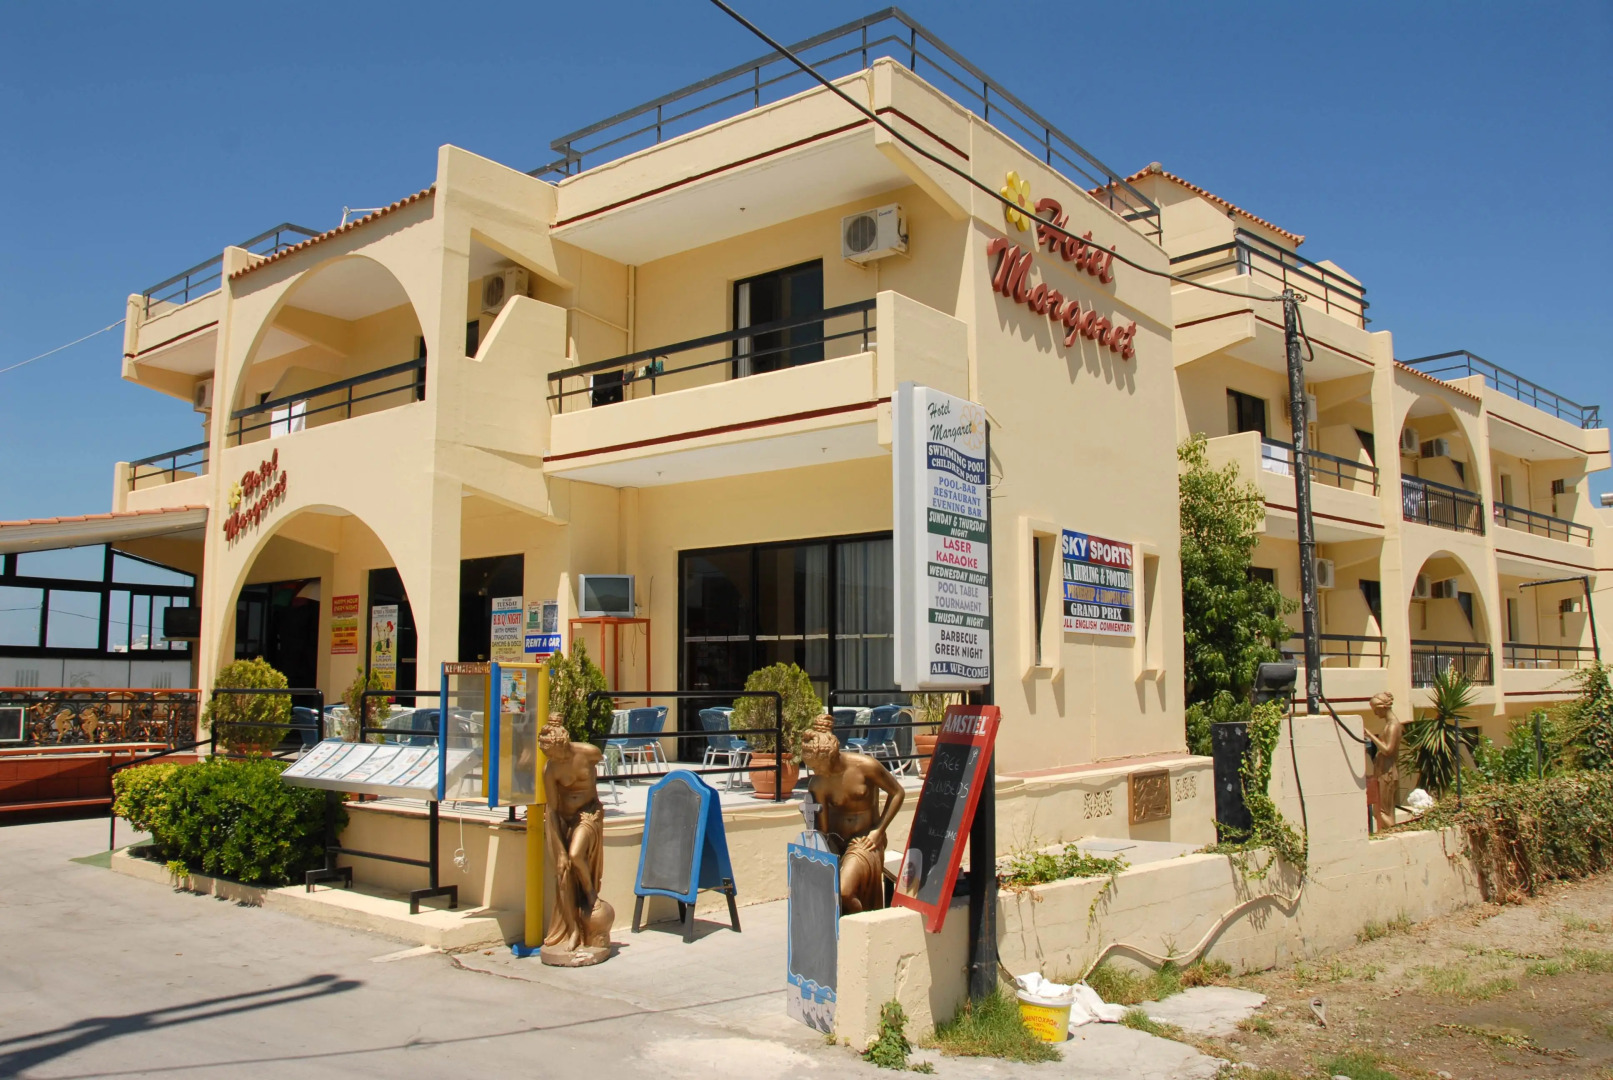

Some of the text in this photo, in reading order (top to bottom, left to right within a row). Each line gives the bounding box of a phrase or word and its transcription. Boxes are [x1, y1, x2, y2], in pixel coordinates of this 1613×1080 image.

[1034, 198, 1116, 284] Hotel
[987, 238, 1137, 360] Margaret
[928, 400, 950, 419] Hotel
[930, 421, 972, 442] Margaret
[928, 445, 985, 473] SWIMMING POOL
[241, 448, 278, 497] Hotel
[931, 458, 982, 484] CHILDREN POOL
[939, 477, 977, 495] POOL-BAR
[223, 470, 287, 541] Margaret
[933, 486, 981, 506] RESTAURANT
[932, 498, 982, 518] EVENING BAR
[929, 511, 986, 533] SUNDAY & THURSDAY
[950, 527, 968, 538] NIGHT
[943, 537, 972, 553] LASER
[1062, 534, 1132, 567] SKY SPORTS
[936, 550, 978, 569] KARAOKE
[929, 564, 987, 585] WEDNESDAY NIGHT
[1073, 564, 1100, 584] HURLING
[1100, 568, 1106, 585] &
[938, 581, 979, 598] POOL TABLE
[935, 596, 982, 612] TOURNAMENT
[1070, 602, 1122, 620] GRAND PRIX
[507, 613, 522, 624] NIGHT
[934, 611, 985, 628] THUSDAY NIGHT
[1075, 619, 1098, 630] ENGLISH
[1100, 621, 1133, 633] COMMENTARY
[525, 637, 561, 648] RENT A CAR
[940, 629, 978, 645] BARBECUE
[935, 643, 983, 659] GREEK NIGHT
[931, 663, 988, 678] ALL WELCOME
[942, 713, 987, 735] AMSTEL
